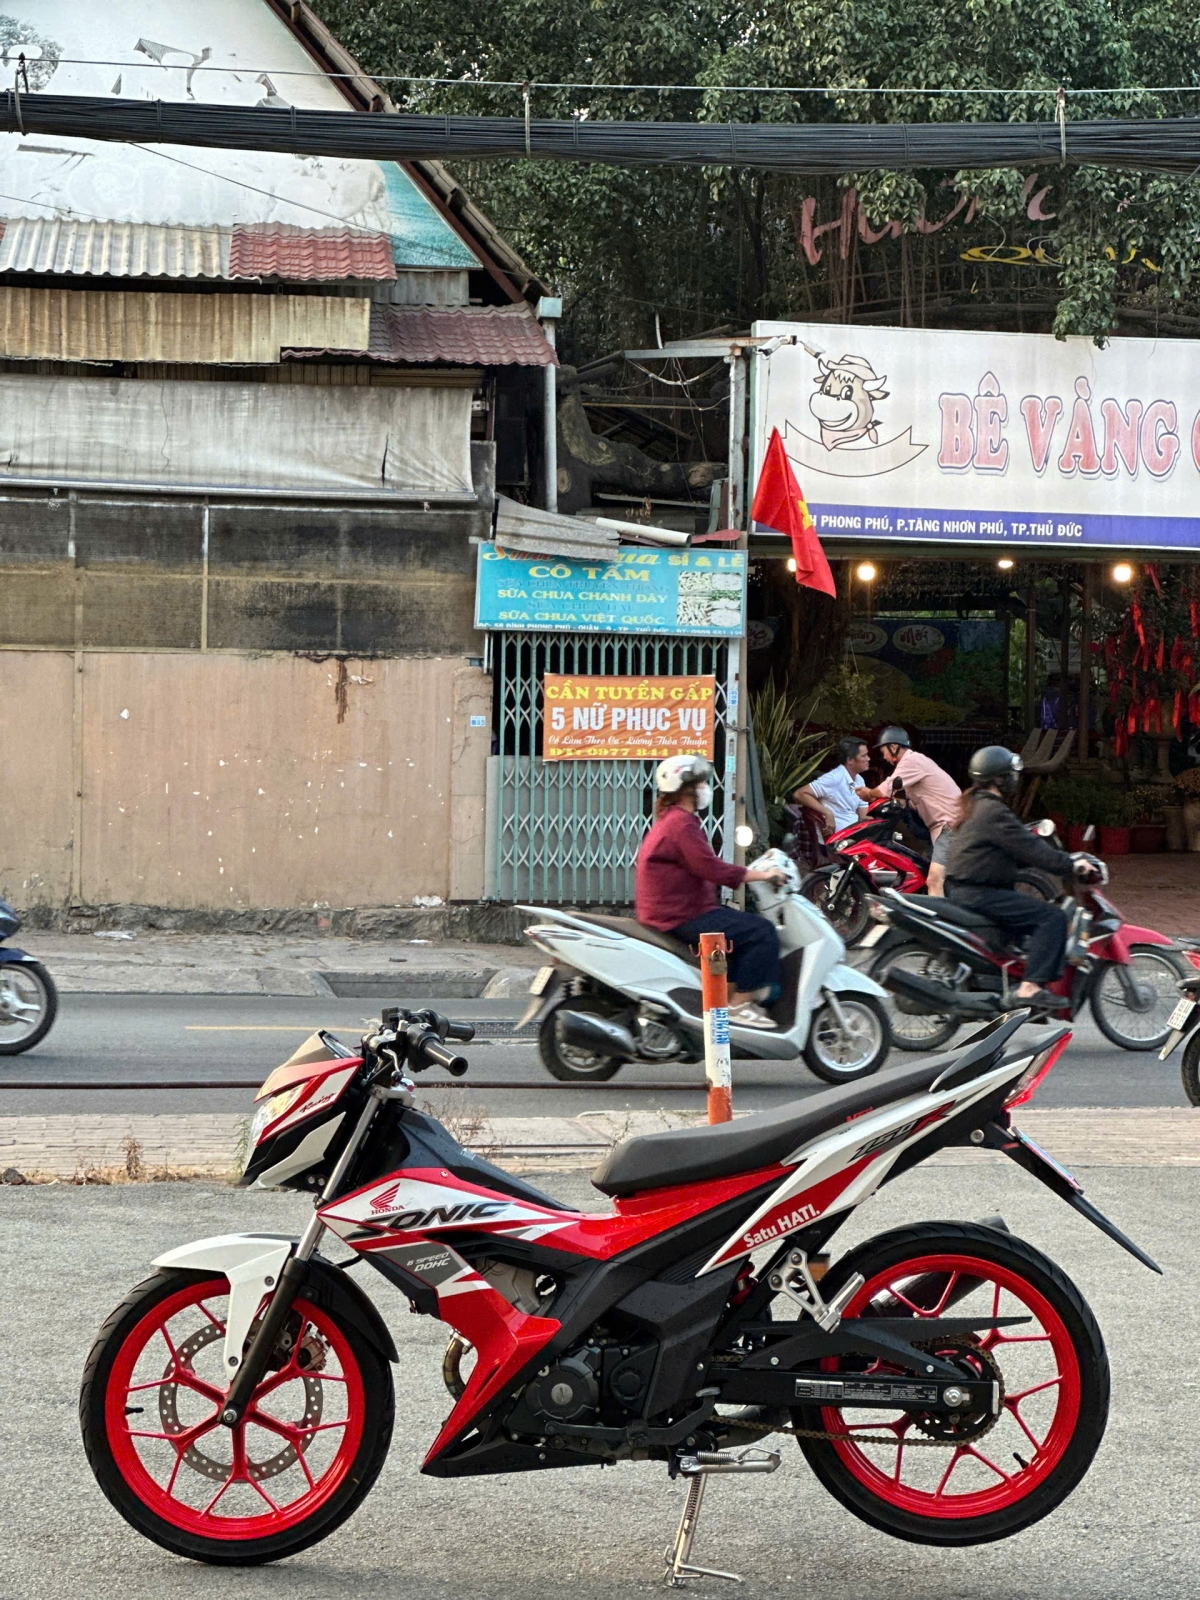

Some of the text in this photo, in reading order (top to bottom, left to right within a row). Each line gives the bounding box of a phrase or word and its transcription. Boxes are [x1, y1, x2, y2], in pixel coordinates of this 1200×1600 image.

[937, 370, 1010, 476] BÊ
[821, 514, 861, 528] PHONG
[864, 515, 893, 532] PHÚ,
[897, 517, 940, 532] P.TĂNG
[943, 520, 976, 533] NHƠN
[979, 519, 1008, 536] PHÚ,
[1011, 520, 1054, 536] TP.THỦ
[1057, 521, 1083, 537] ĐỨC
[695, 556, 711, 567] &
[528, 564, 650, 582] CÔ TẤM
[497, 588, 668, 603] SỮA CHUA CHANH DÂY
[498, 610, 666, 625] SỮA CHUA VIỆT QUỐC
[546, 680, 590, 700] CẦN
[595, 680, 665, 700] TUYỂN
[670, 681, 713, 701] GẤP
[551, 702, 706, 736] 5 NỮ PHỤC VỤ
[562, 736, 582, 745] Làm
[585, 735, 606, 745] Theo
[371, 1205, 405, 1215] HONDA
[344, 1201, 518, 1242] SONIC
[743, 1225, 778, 1248] Satu
[406, 1252, 449, 1267] 6 SPEED
[413, 1257, 451, 1272] DOHC
